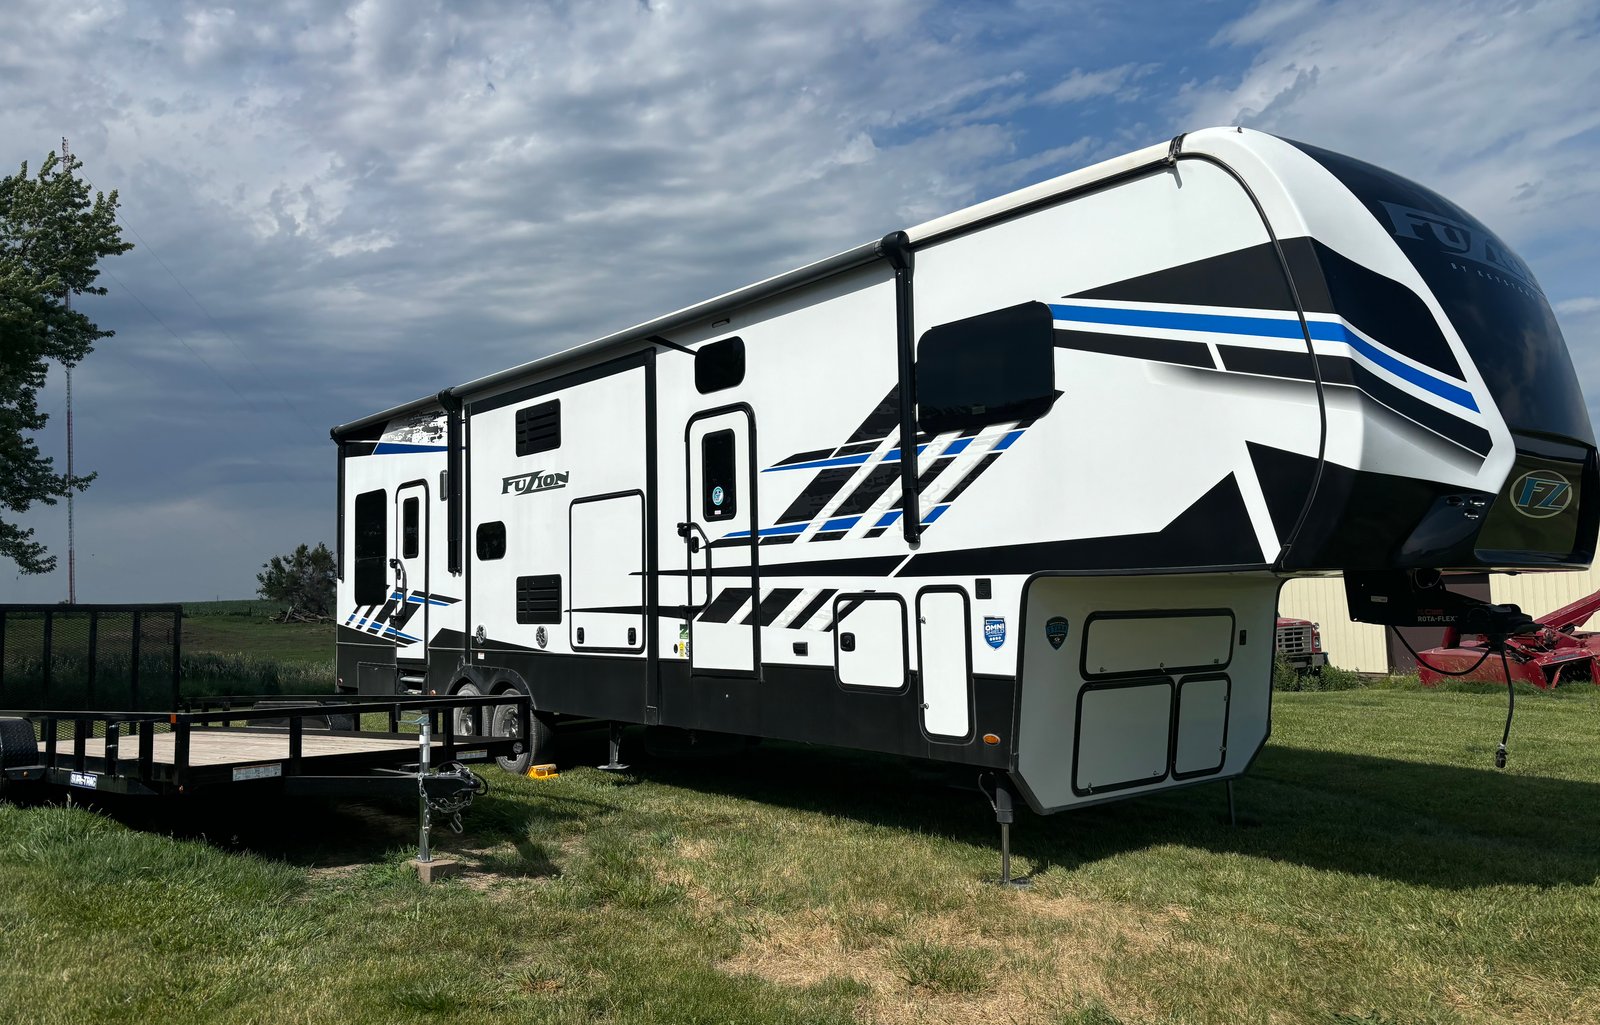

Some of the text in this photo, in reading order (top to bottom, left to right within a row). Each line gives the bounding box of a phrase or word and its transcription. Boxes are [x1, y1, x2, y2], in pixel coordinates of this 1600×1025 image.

[1450, 262, 1477, 272] BY
[501, 469, 569, 496] FUZION
[1517, 476, 1571, 509] FZ
[985, 623, 1004, 631] OMNI
